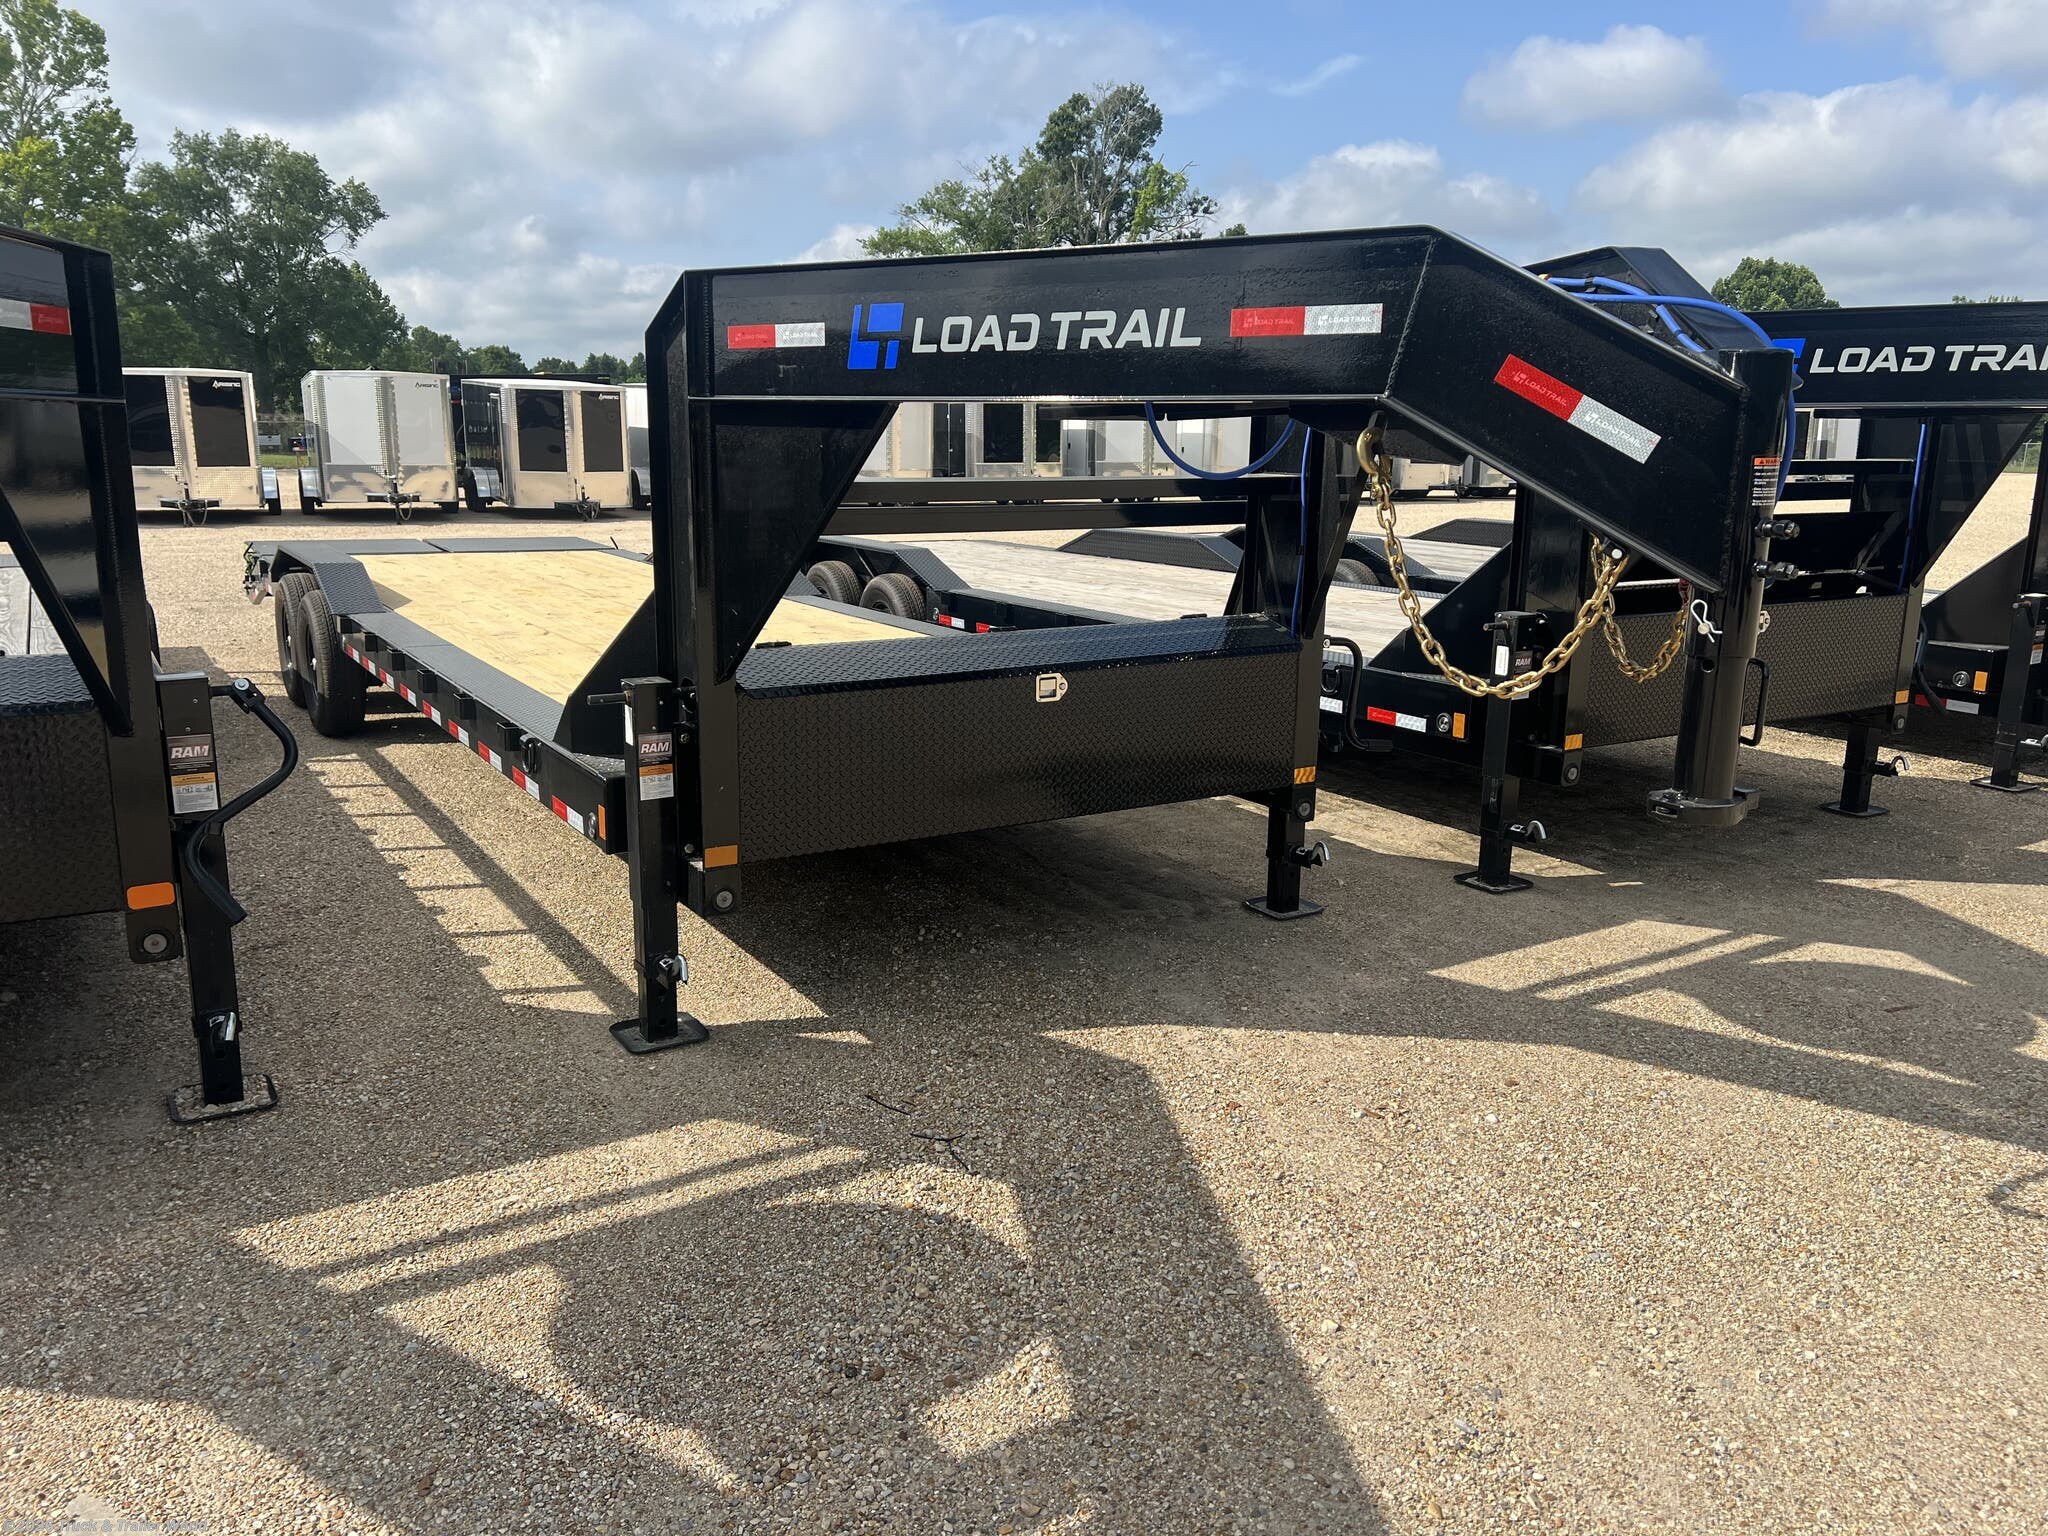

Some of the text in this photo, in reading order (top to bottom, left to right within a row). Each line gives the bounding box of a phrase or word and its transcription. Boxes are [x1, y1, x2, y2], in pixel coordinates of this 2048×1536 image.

[912, 307, 1202, 353] LOAD TRAIL
[1809, 346, 1936, 374] LOAD
[1515, 658, 1531, 667] RAM
[171, 745, 209, 759] RAM
[641, 742, 669, 754] RAM
